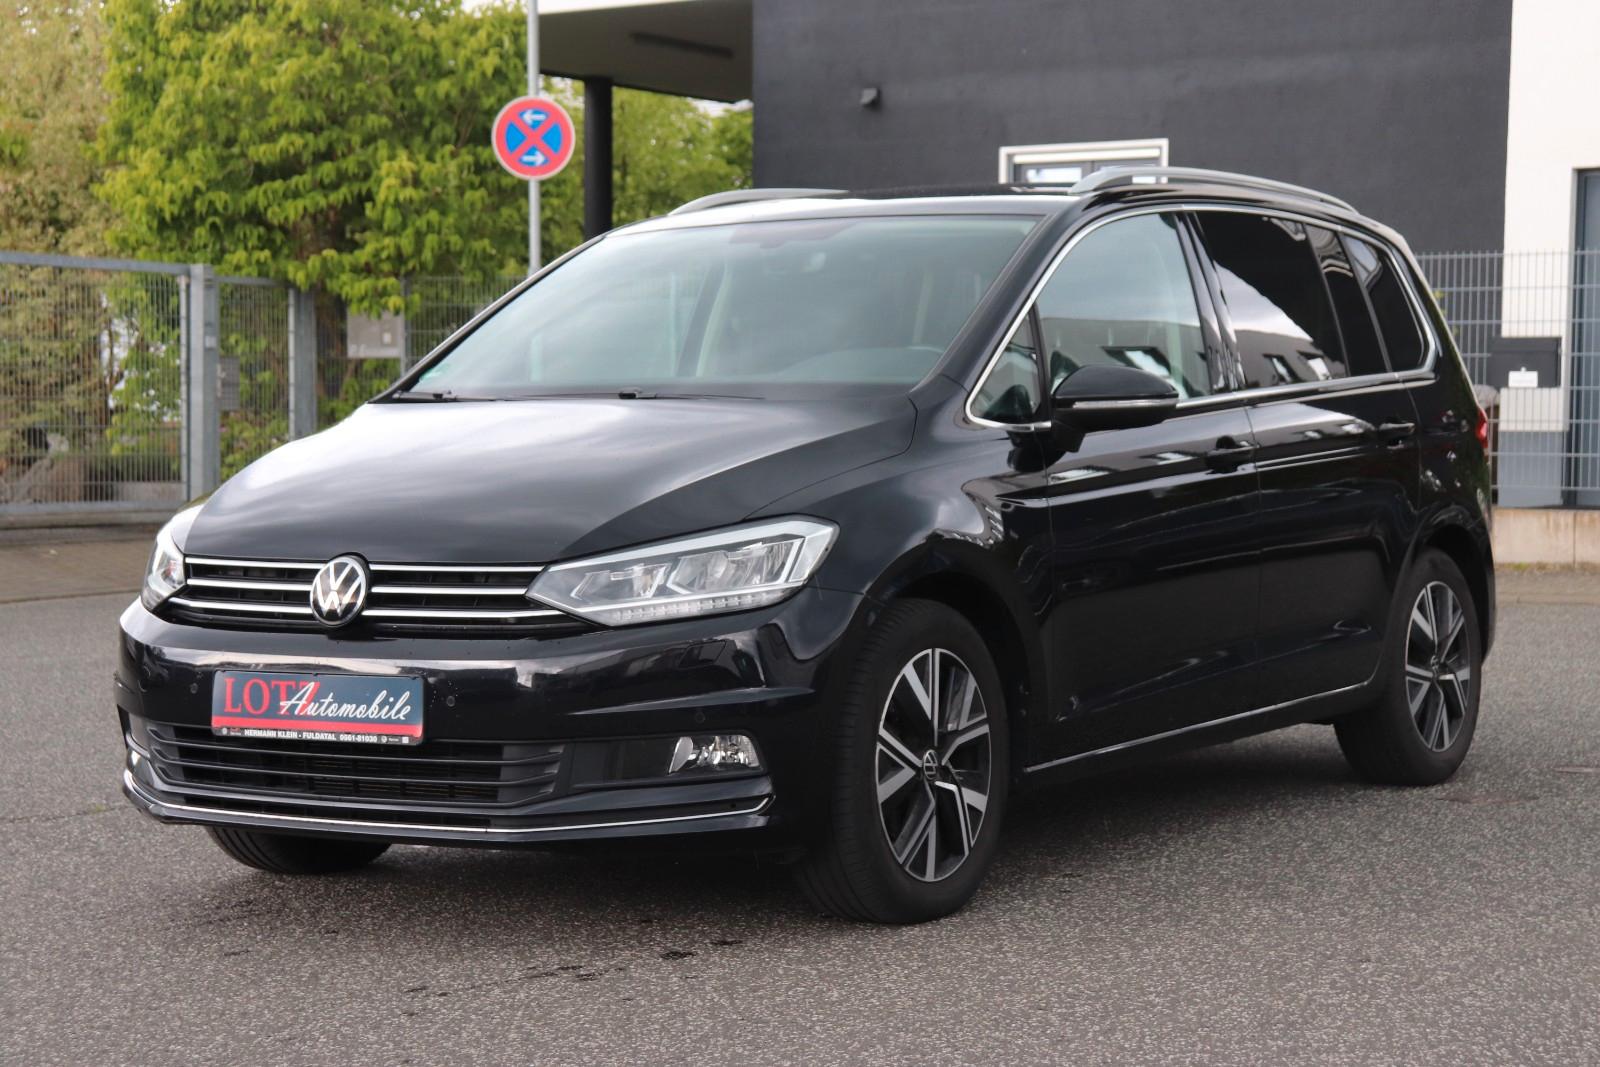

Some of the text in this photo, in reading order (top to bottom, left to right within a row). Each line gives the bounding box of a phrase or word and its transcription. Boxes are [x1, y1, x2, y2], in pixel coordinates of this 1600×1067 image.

[311, 558, 365, 624] VW
[280, 681, 411, 721] Automobile
[244, 729, 276, 738] HERMANN
[277, 731, 298, 739] KLEIN
[302, 732, 336, 741] FULDATAL
